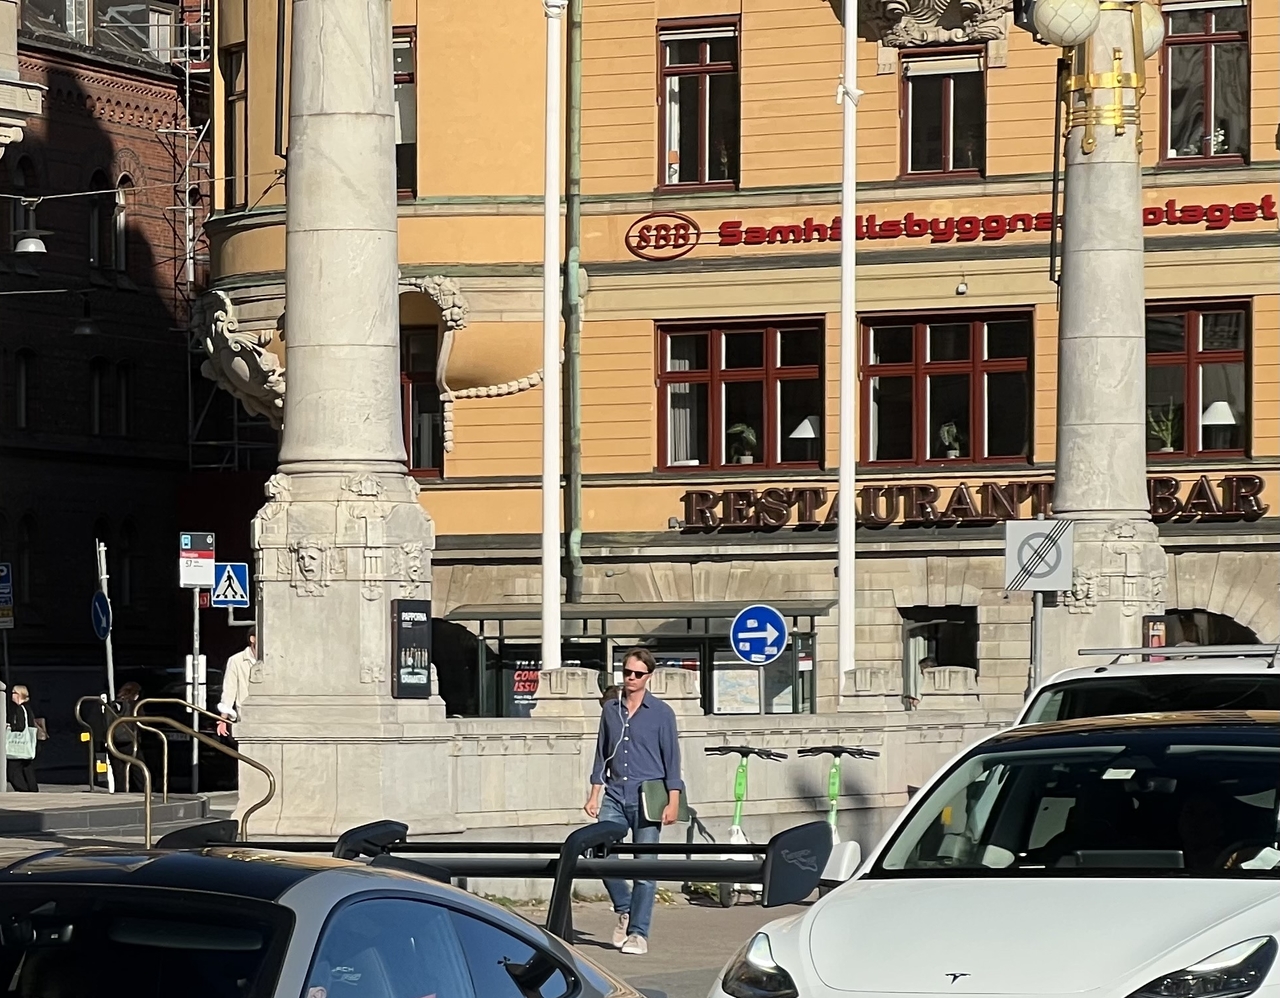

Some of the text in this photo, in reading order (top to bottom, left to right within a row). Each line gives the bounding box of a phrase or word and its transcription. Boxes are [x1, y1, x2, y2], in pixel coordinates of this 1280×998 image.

[637, 223, 691, 250] SBB
[680, 474, 1269, 533] RESTAURANT BAR
